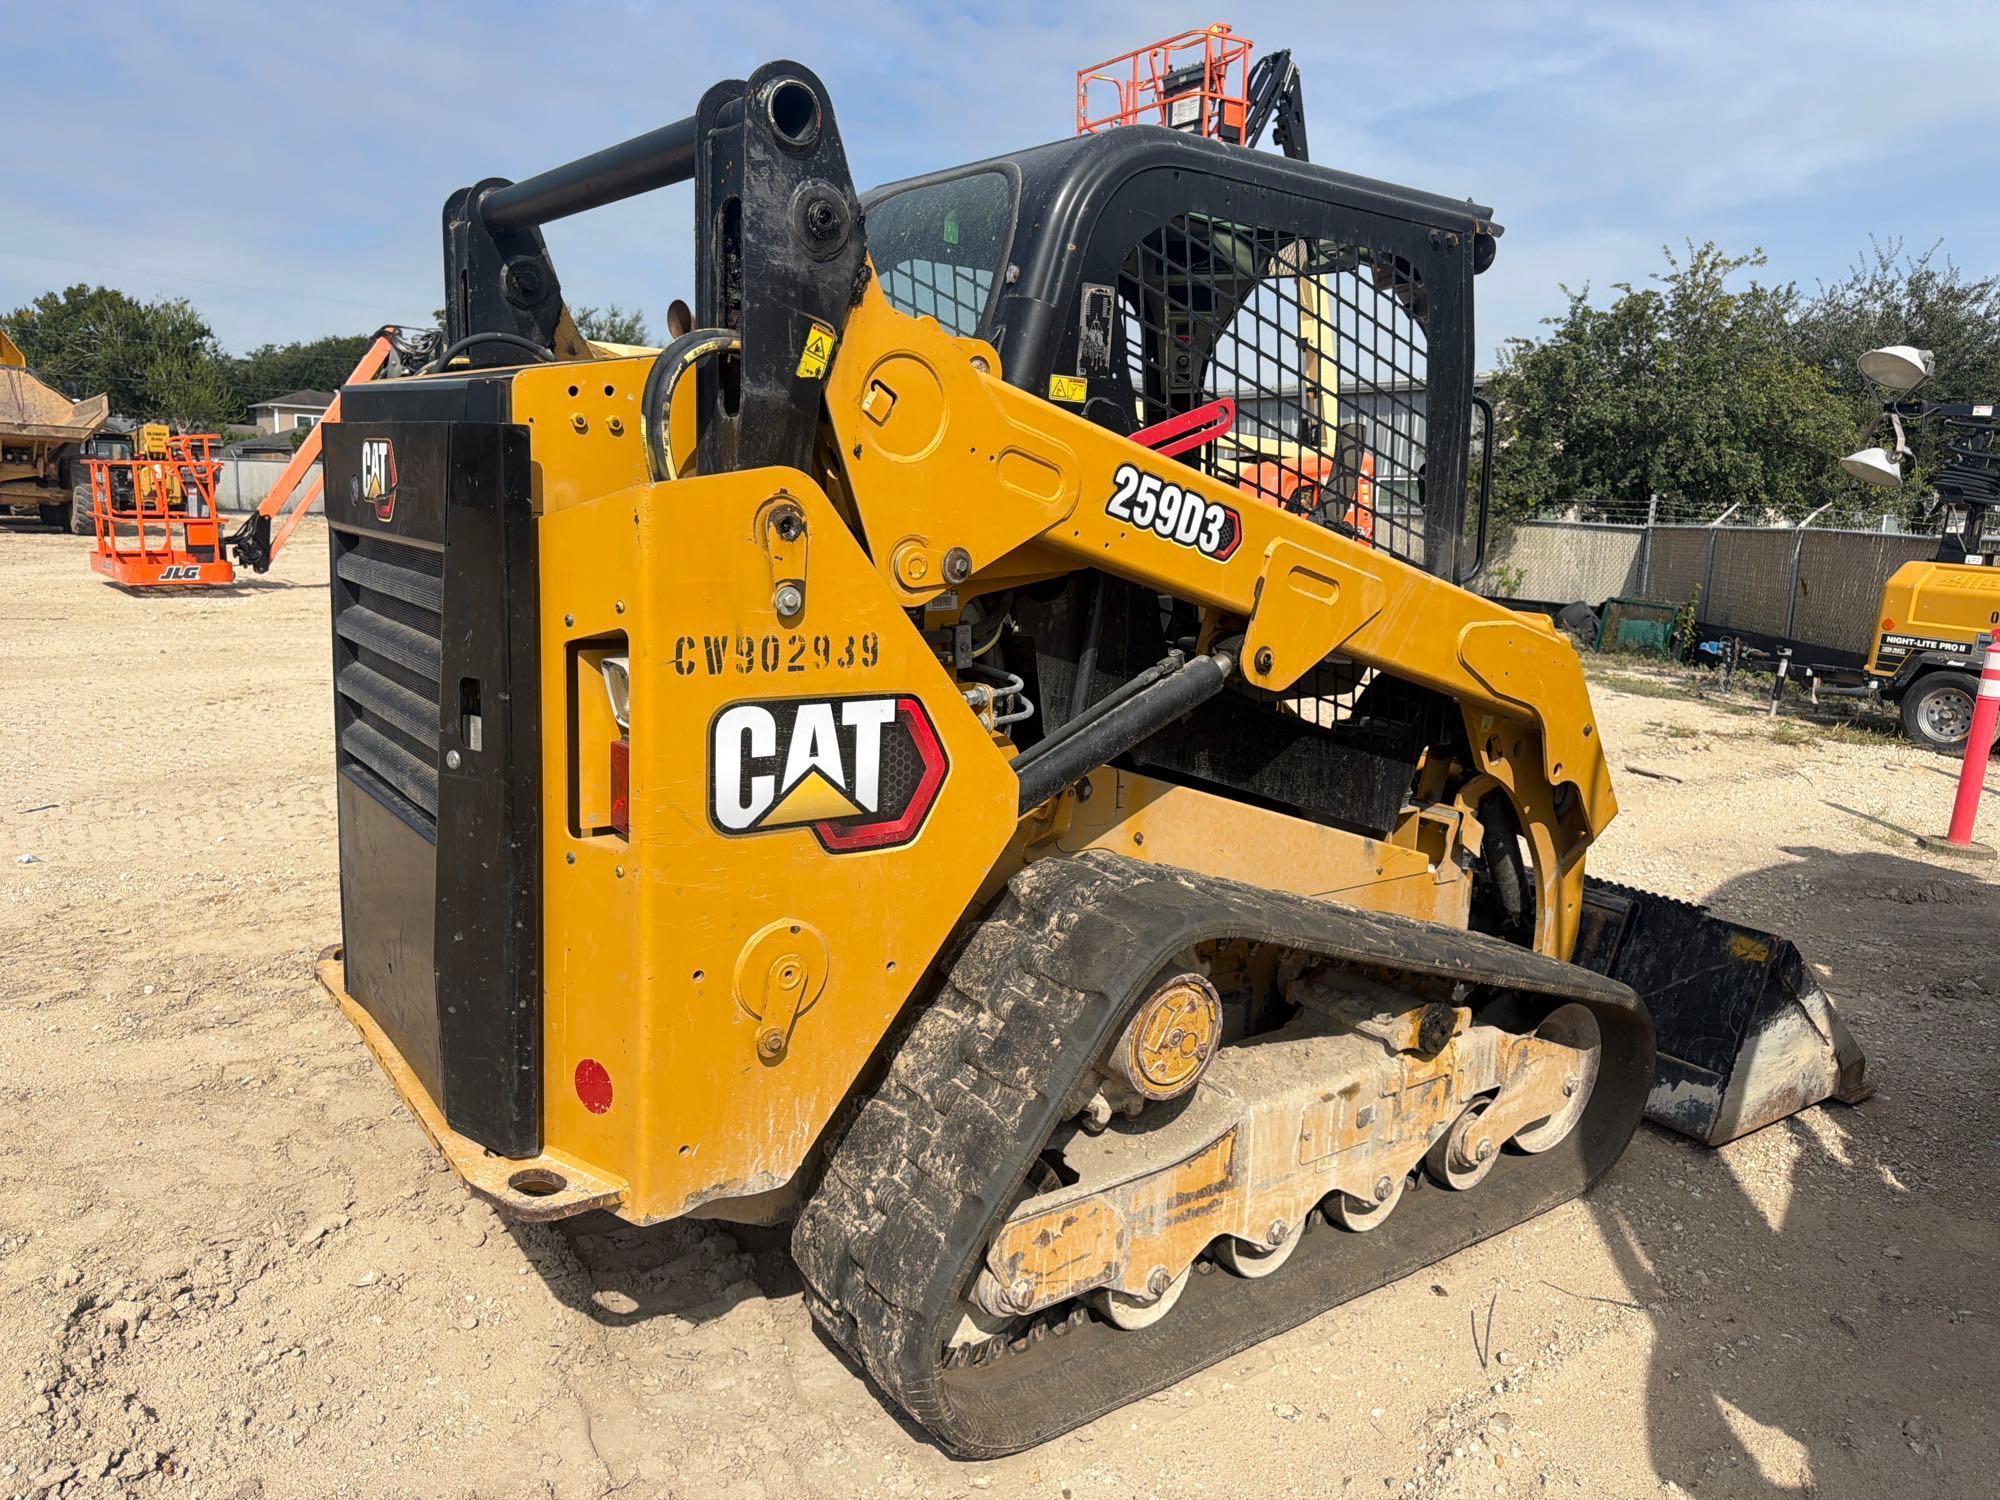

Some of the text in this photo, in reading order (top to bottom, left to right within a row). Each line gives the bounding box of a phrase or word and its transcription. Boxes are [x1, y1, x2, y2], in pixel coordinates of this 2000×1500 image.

[362, 441, 388, 498] CAT
[1107, 466, 1226, 553] 259D3
[158, 566, 200, 582] JLG
[675, 631, 880, 676] CW902939
[1886, 635, 1937, 649] NIGHT-LITE
[1938, 642, 1959, 652] PRO
[715, 699, 896, 829] CAT
